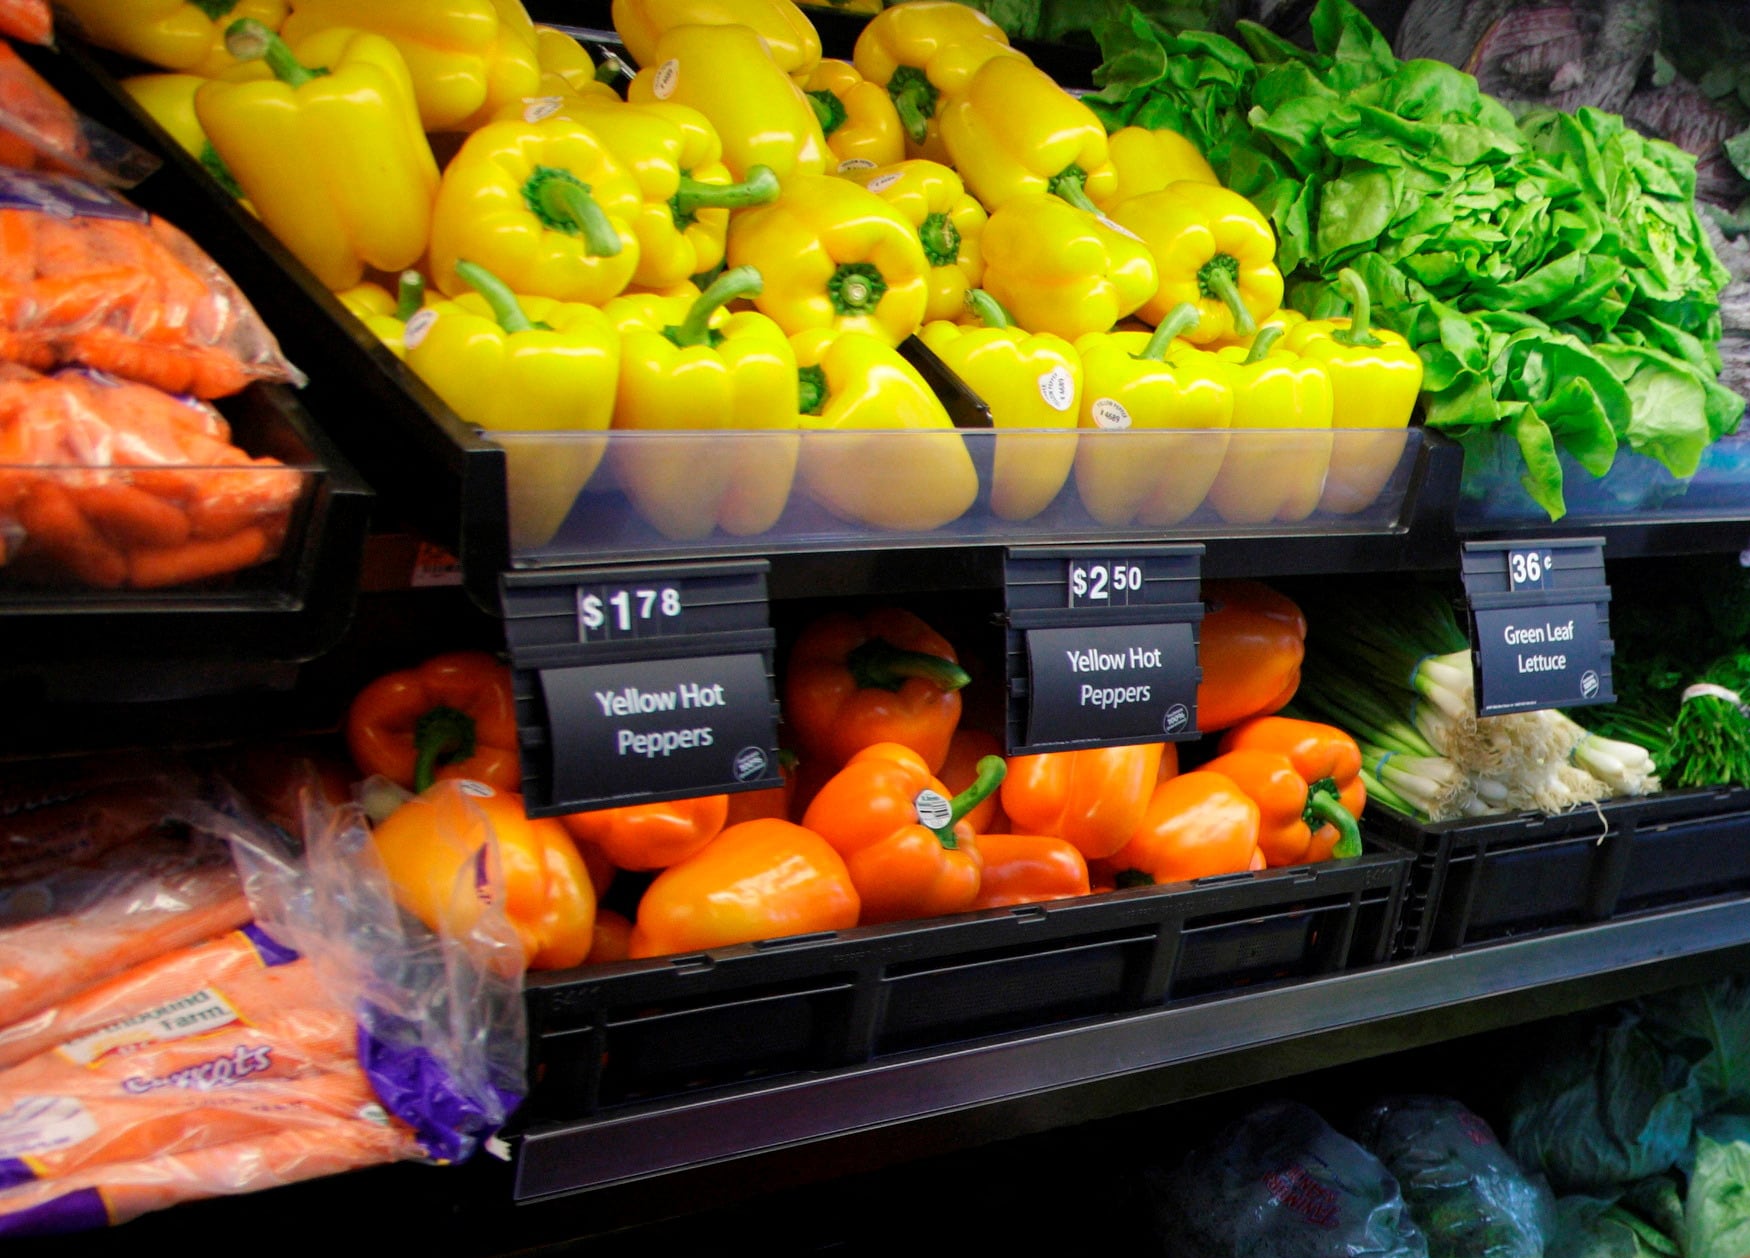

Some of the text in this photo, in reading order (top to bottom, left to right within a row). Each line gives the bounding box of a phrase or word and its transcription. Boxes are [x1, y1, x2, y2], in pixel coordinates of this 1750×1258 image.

[1504, 620, 1574, 646] Green Leaf
[1066, 647, 1162, 673] Yellow Hot
[1518, 654, 1567, 674] Lettuce
[595, 683, 726, 717] Yellow Hot
[1081, 684, 1151, 710] Peppers
[618, 727, 714, 758] Peppers
